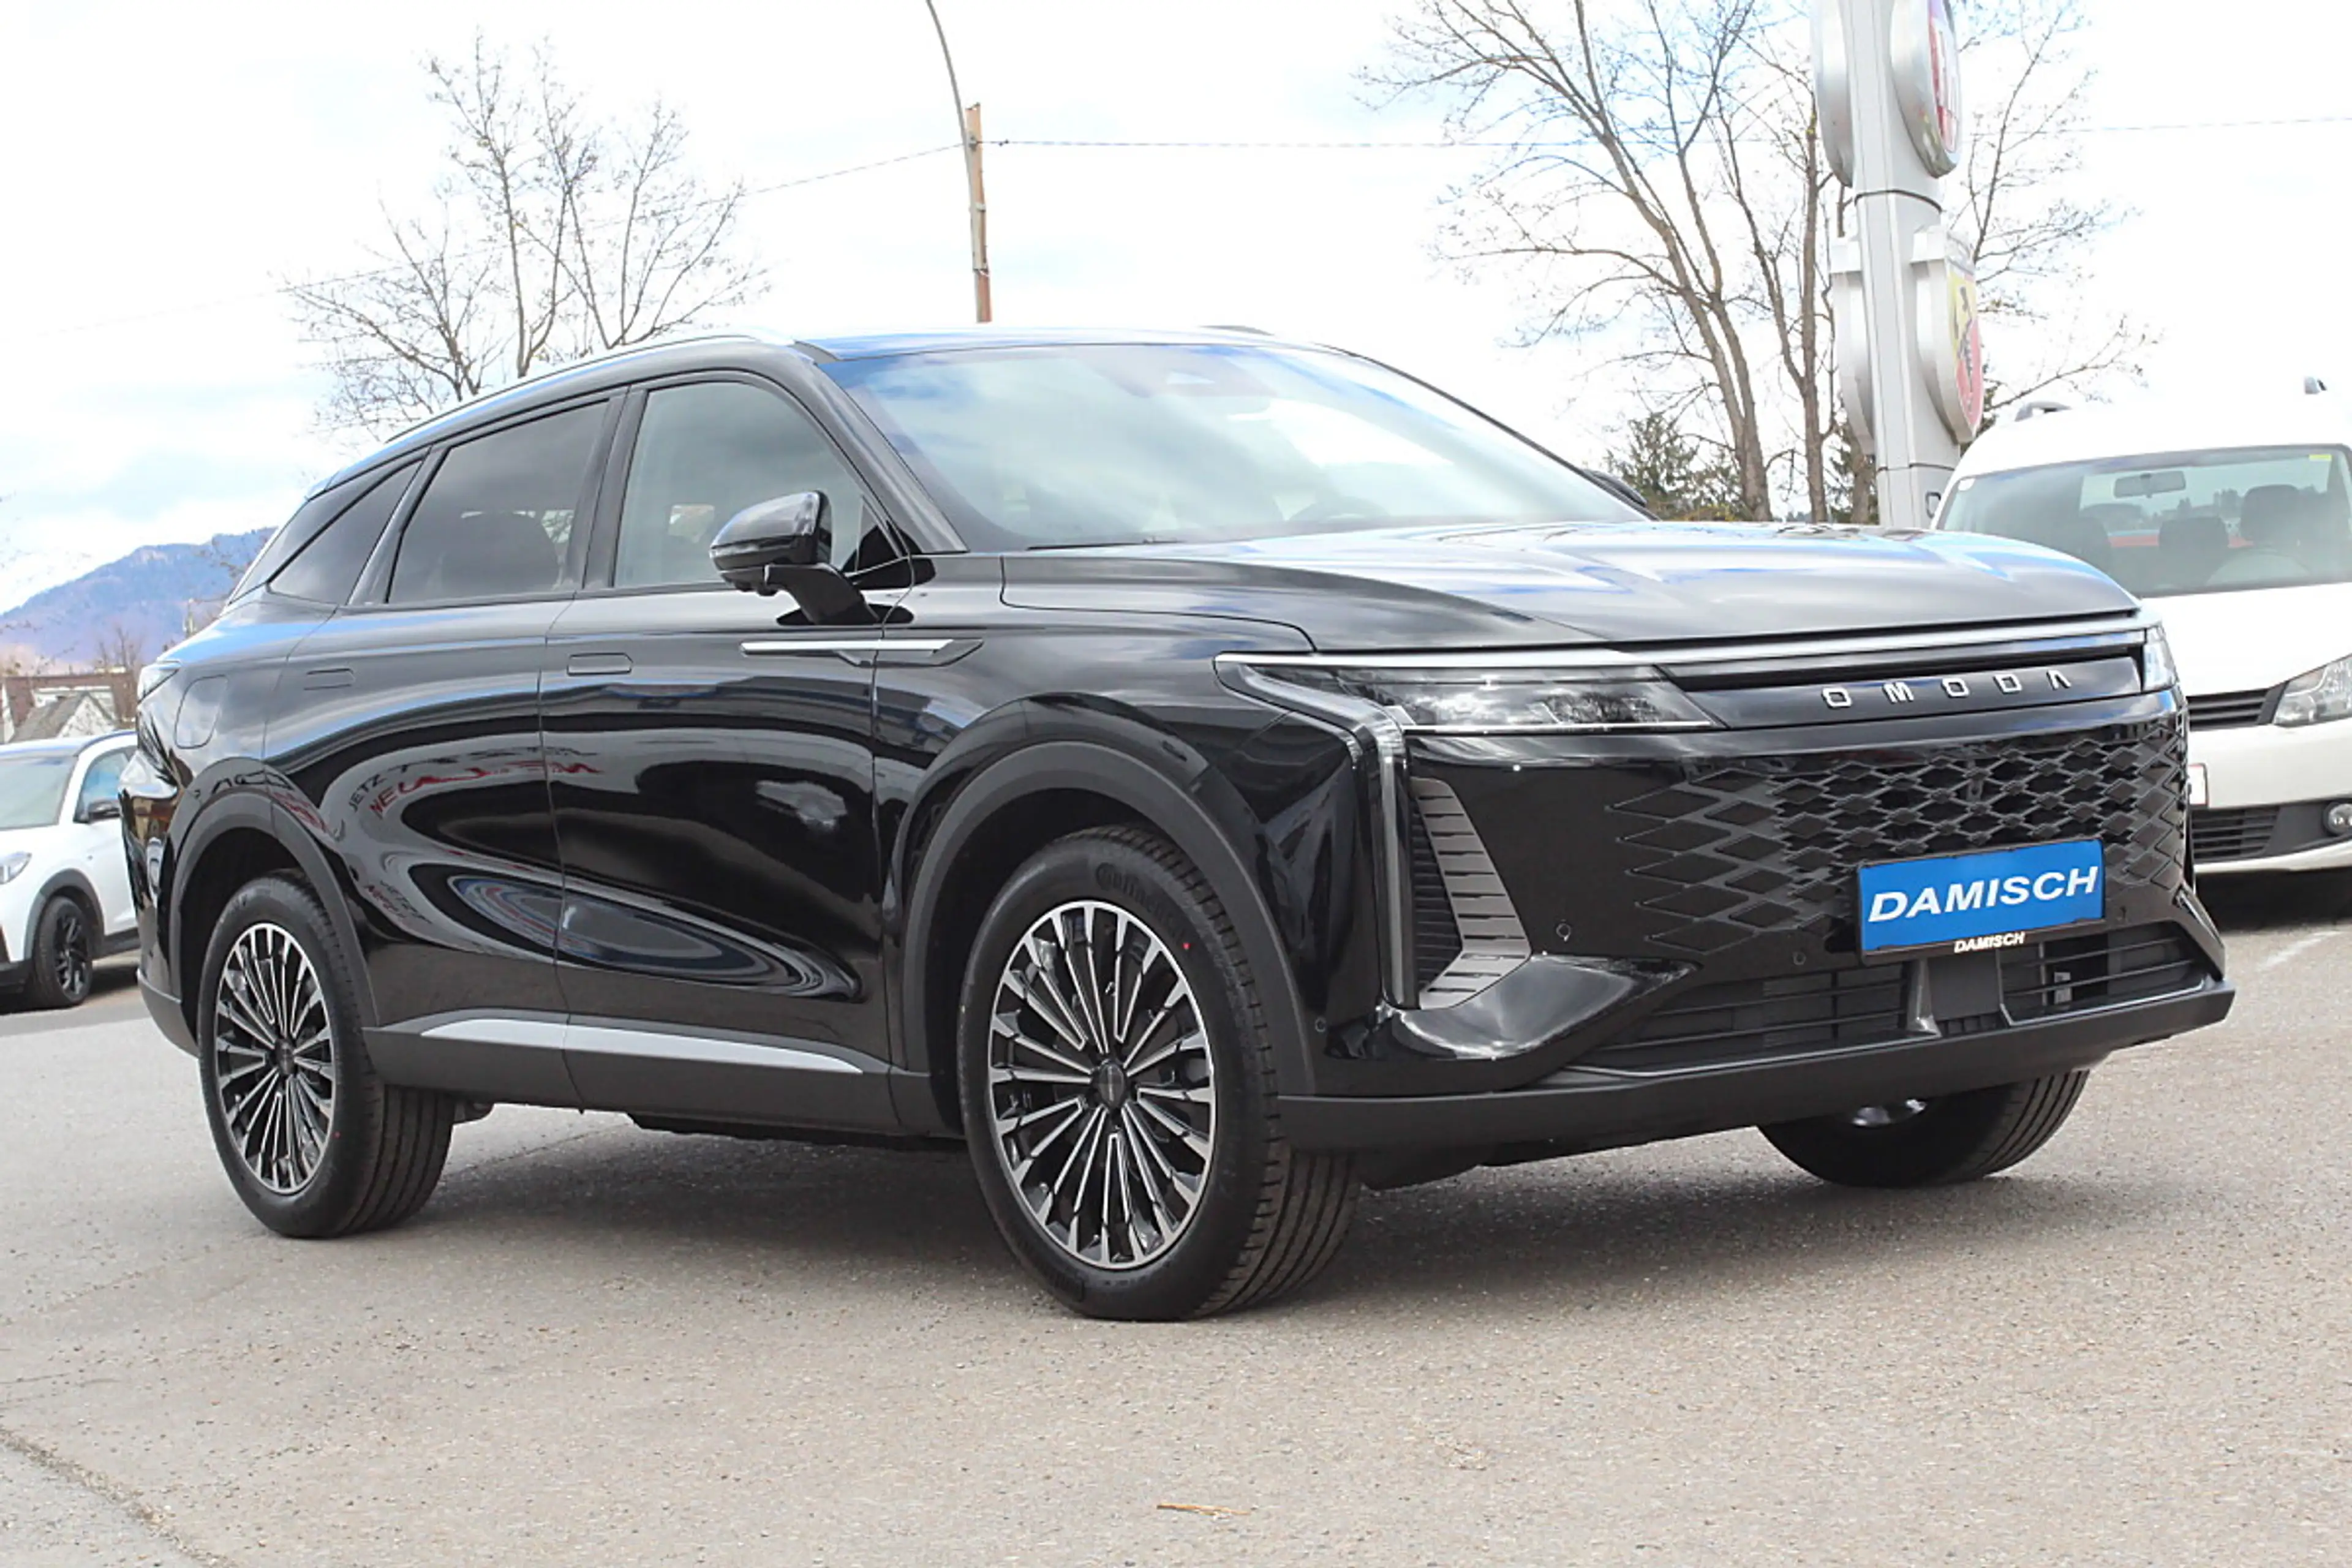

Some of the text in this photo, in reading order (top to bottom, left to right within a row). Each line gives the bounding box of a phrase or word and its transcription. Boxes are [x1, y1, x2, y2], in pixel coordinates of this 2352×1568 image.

[1822, 669, 2071, 708] OMODA
[1868, 865, 2098, 922] DAMISCH
[1954, 932, 2026, 953] DAMISCH
